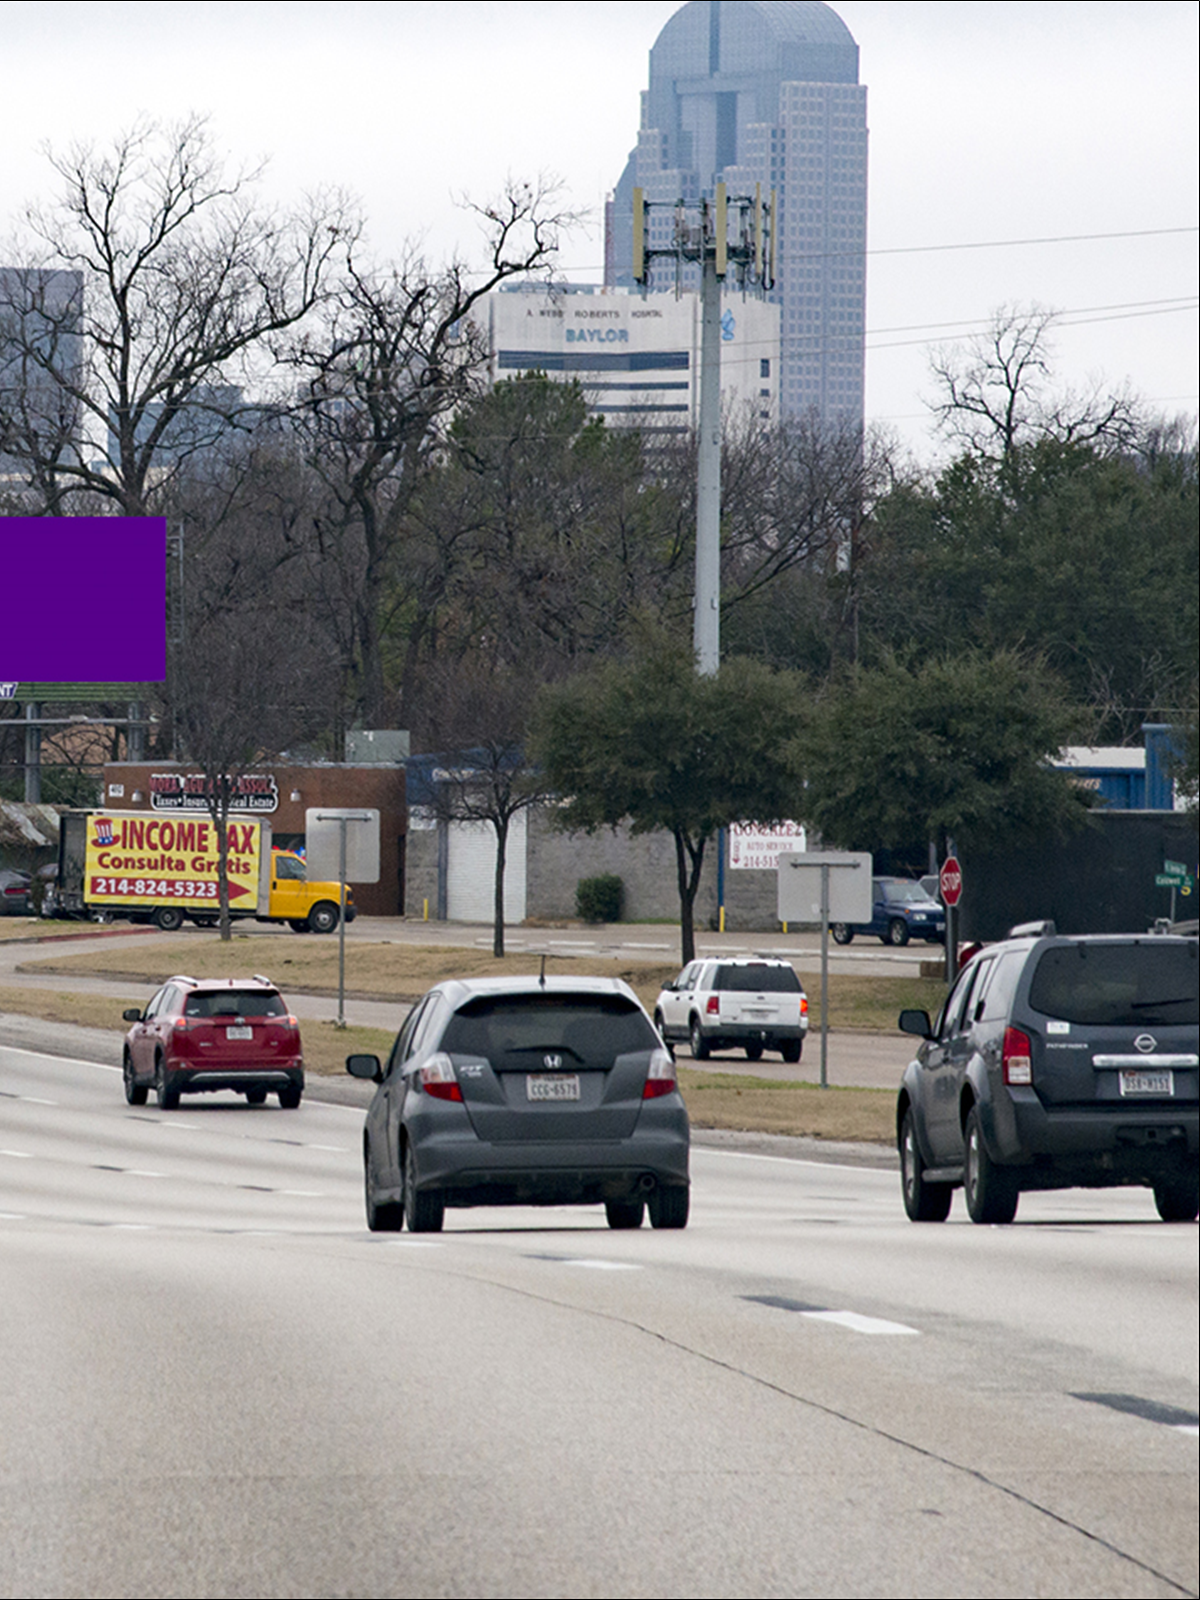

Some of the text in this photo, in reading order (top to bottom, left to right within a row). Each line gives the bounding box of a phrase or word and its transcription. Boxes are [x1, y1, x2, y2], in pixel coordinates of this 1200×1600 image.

[574, 309, 621, 319] ROBERTS
[565, 328, 629, 343] BAYLOR
[249, 794, 274, 807] Estate
[121, 820, 208, 853] INCOME
[747, 842, 764, 851] AUTO
[766, 842, 794, 851] SERVICE
[97, 852, 186, 873] Consulta
[95, 878, 217, 898] 214-824-5323
[941, 872, 961, 891] STOP
